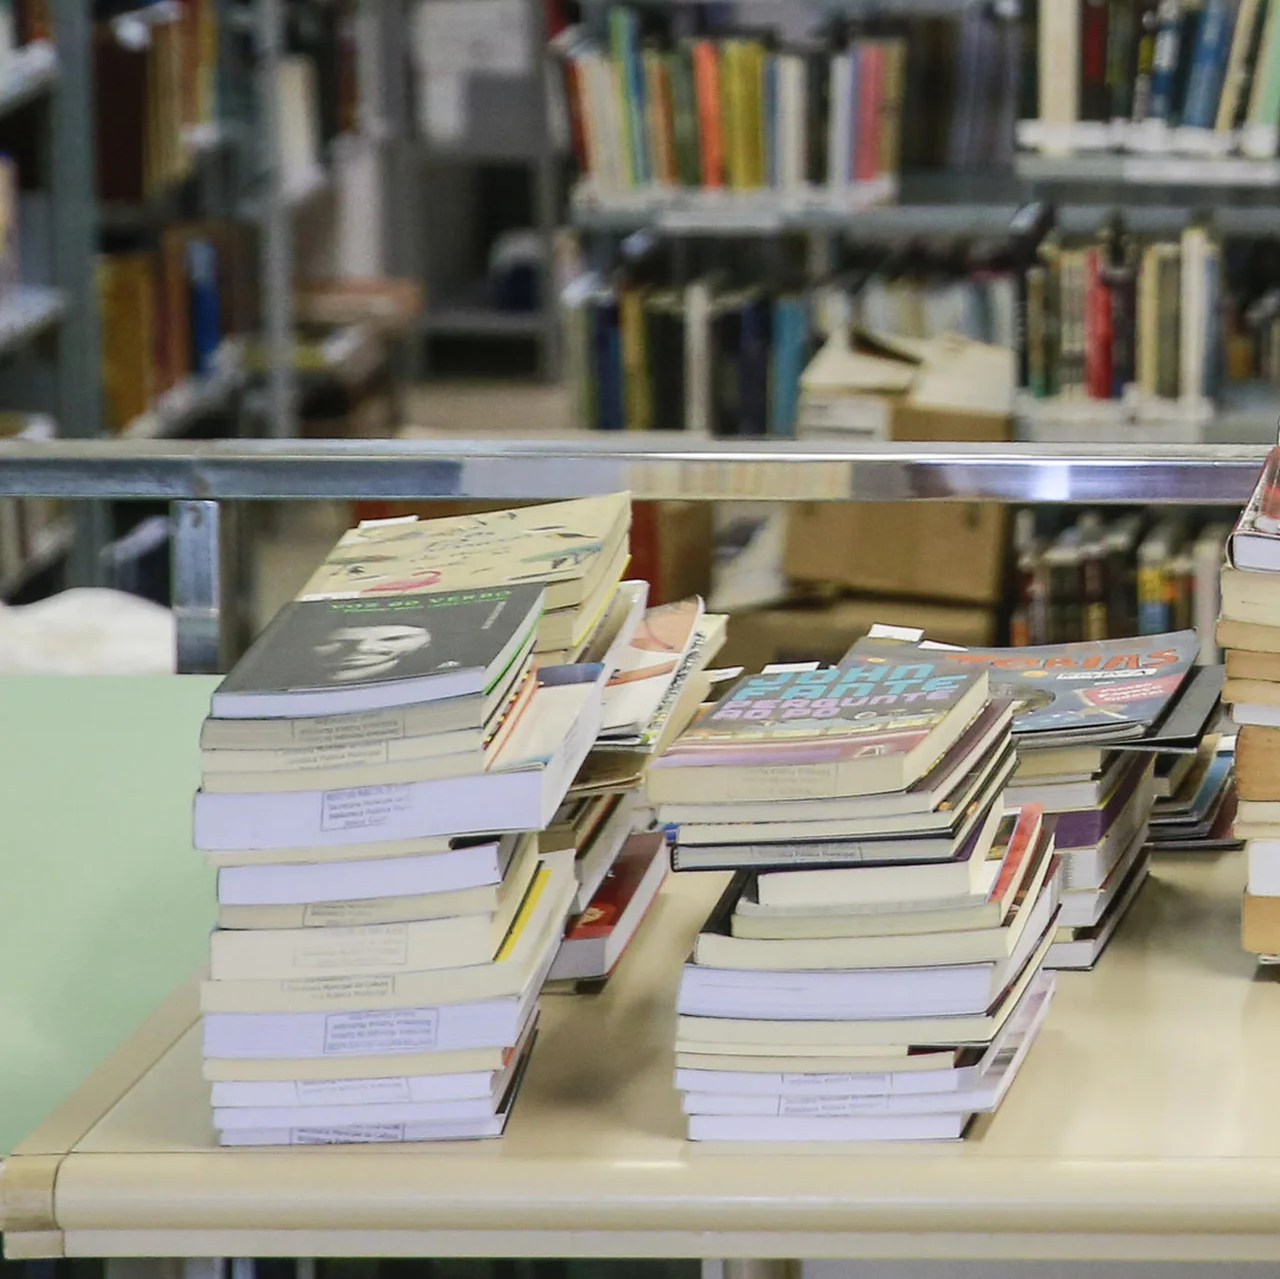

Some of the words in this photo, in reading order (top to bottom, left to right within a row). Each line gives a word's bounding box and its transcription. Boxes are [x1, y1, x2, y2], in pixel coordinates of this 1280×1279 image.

[945, 648, 1180, 671] TOBIAS
[748, 663, 936, 687] JOHN
[731, 675, 969, 701] FANTE
[720, 689, 957, 711] PERGUNTE
[711, 709, 766, 721] AO
